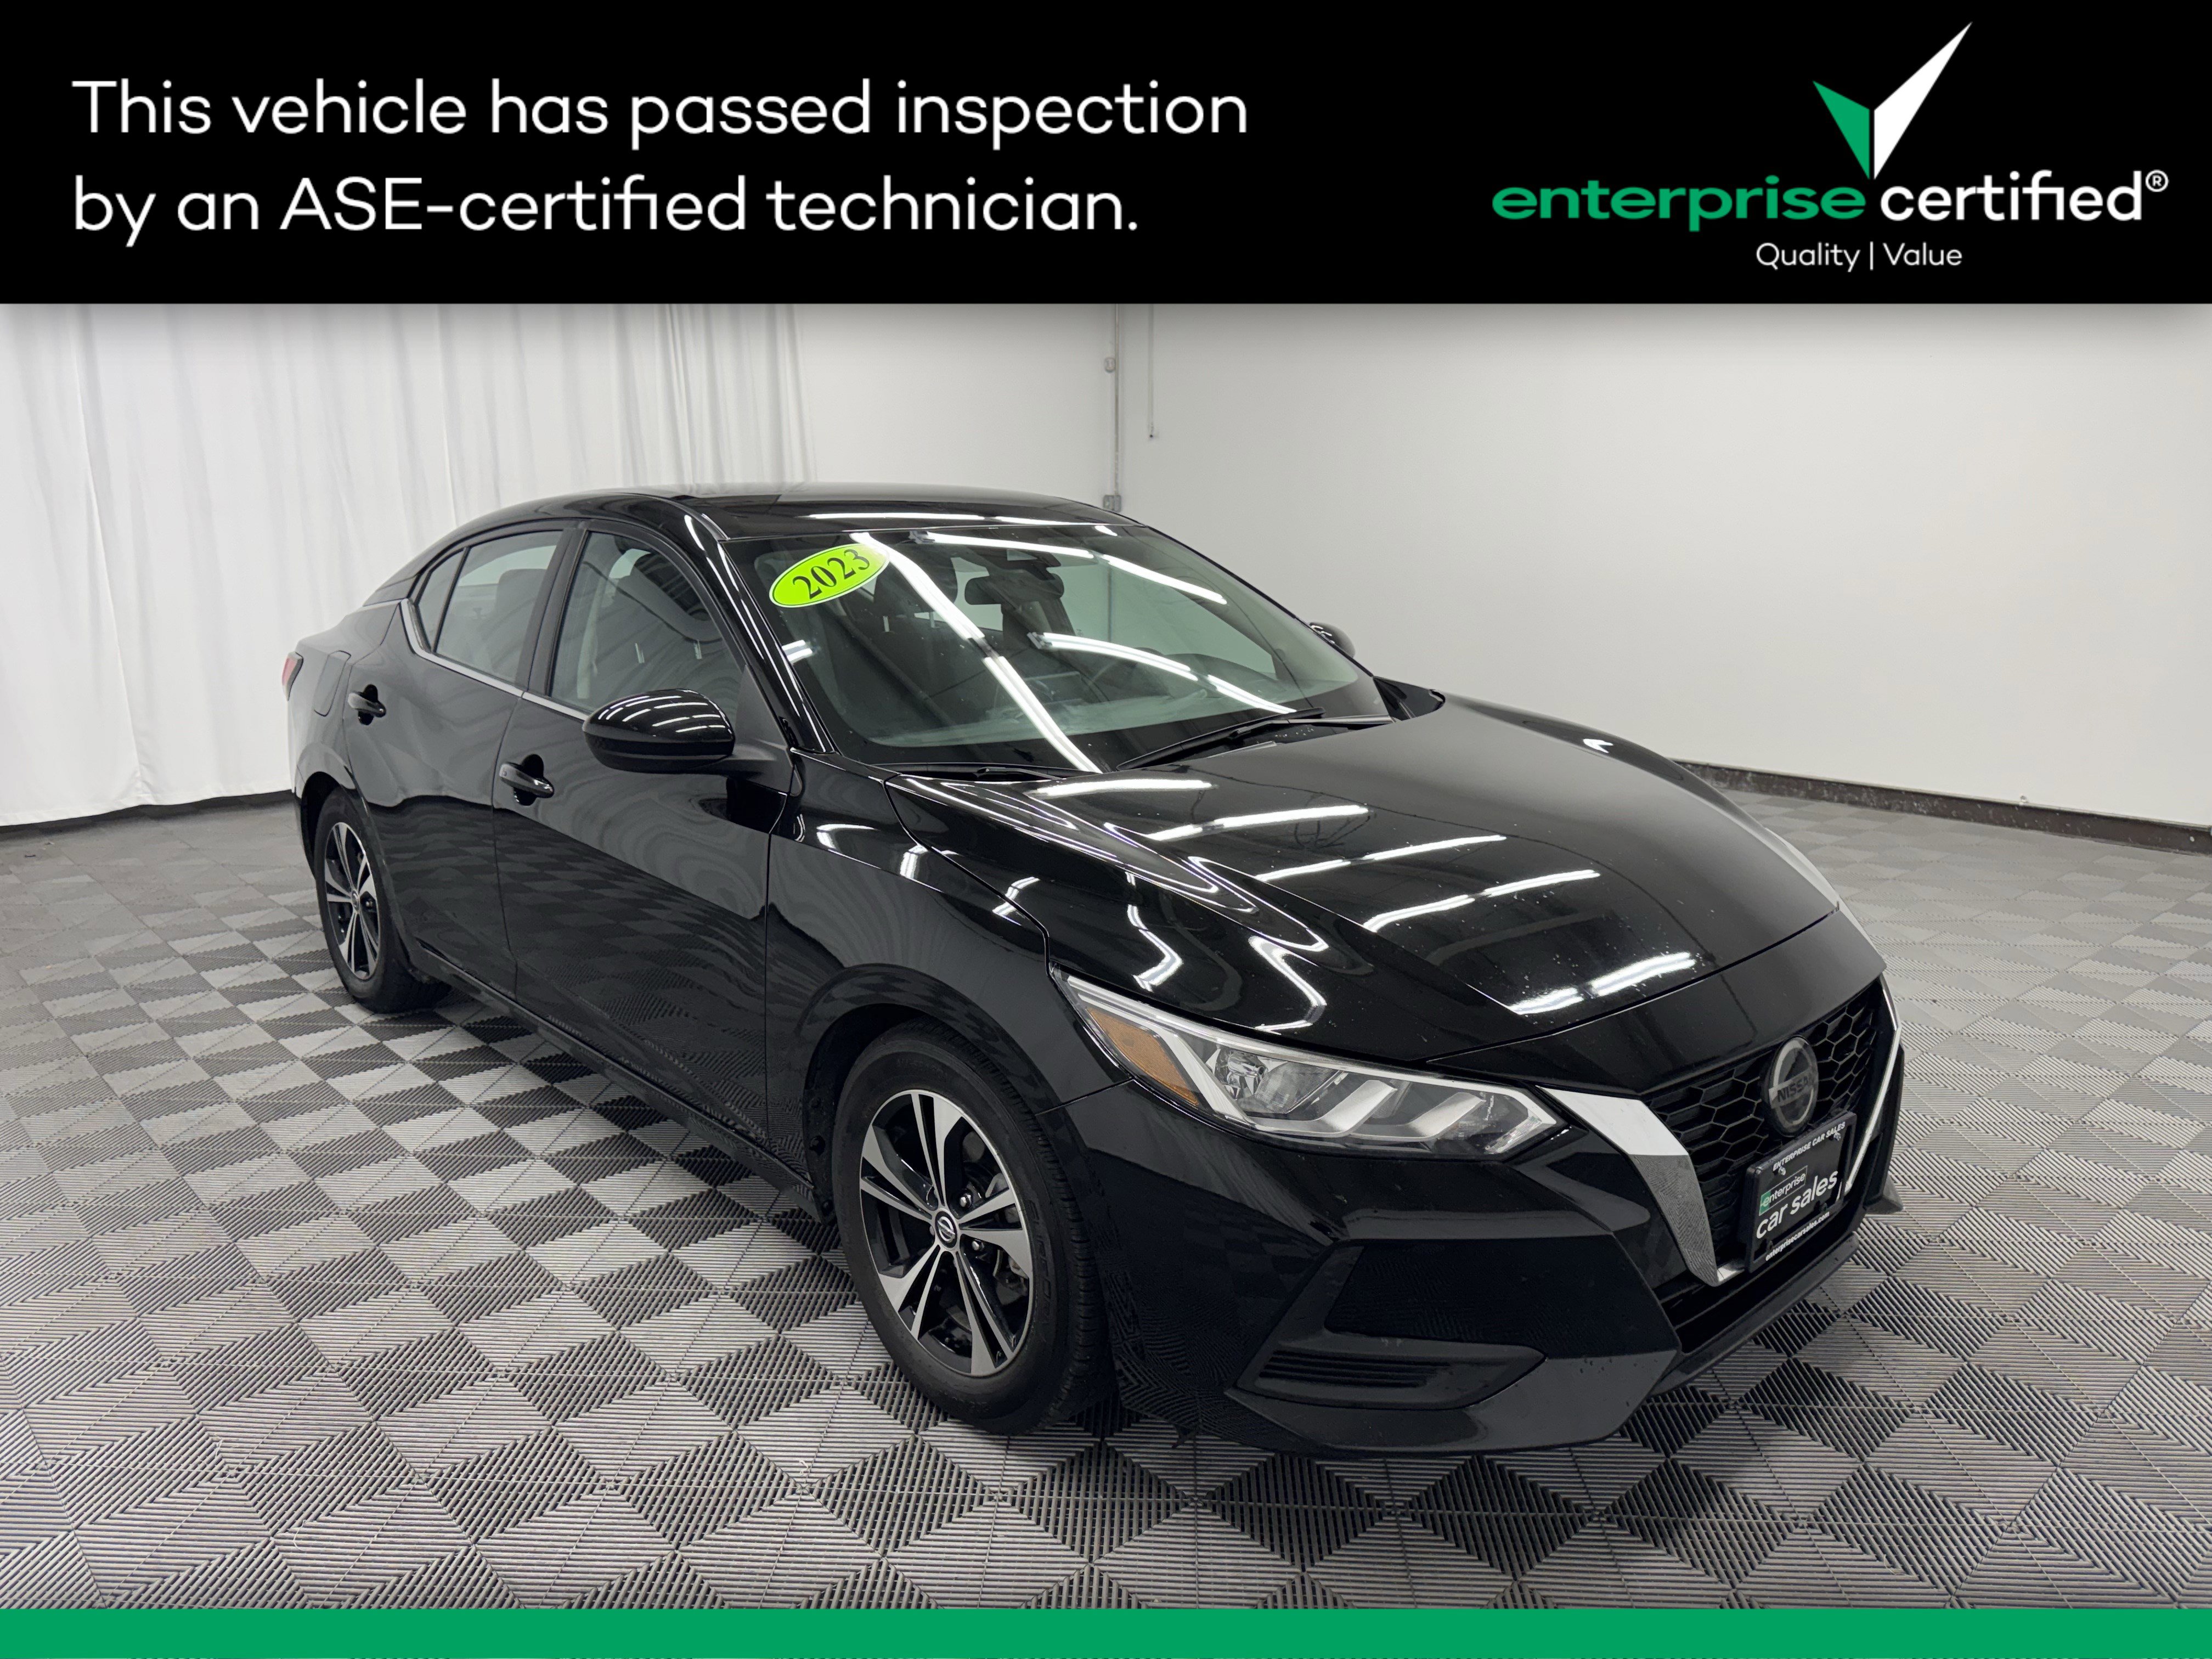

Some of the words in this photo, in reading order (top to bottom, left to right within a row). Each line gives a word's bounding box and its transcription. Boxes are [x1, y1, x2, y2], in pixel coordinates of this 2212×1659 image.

[793, 549, 870, 599] 2023
[1773, 1142, 1811, 1171] ENTERPRISE
[1812, 1133, 1826, 1147] CAR
[1826, 1121, 1845, 1138] SALES
[1756, 1203, 1788, 1239] car
[1790, 1171, 1838, 1215] sales
[1761, 1173, 1805, 1207] enterprise
[1765, 1211, 1830, 1261] enterprisecarsales.com
